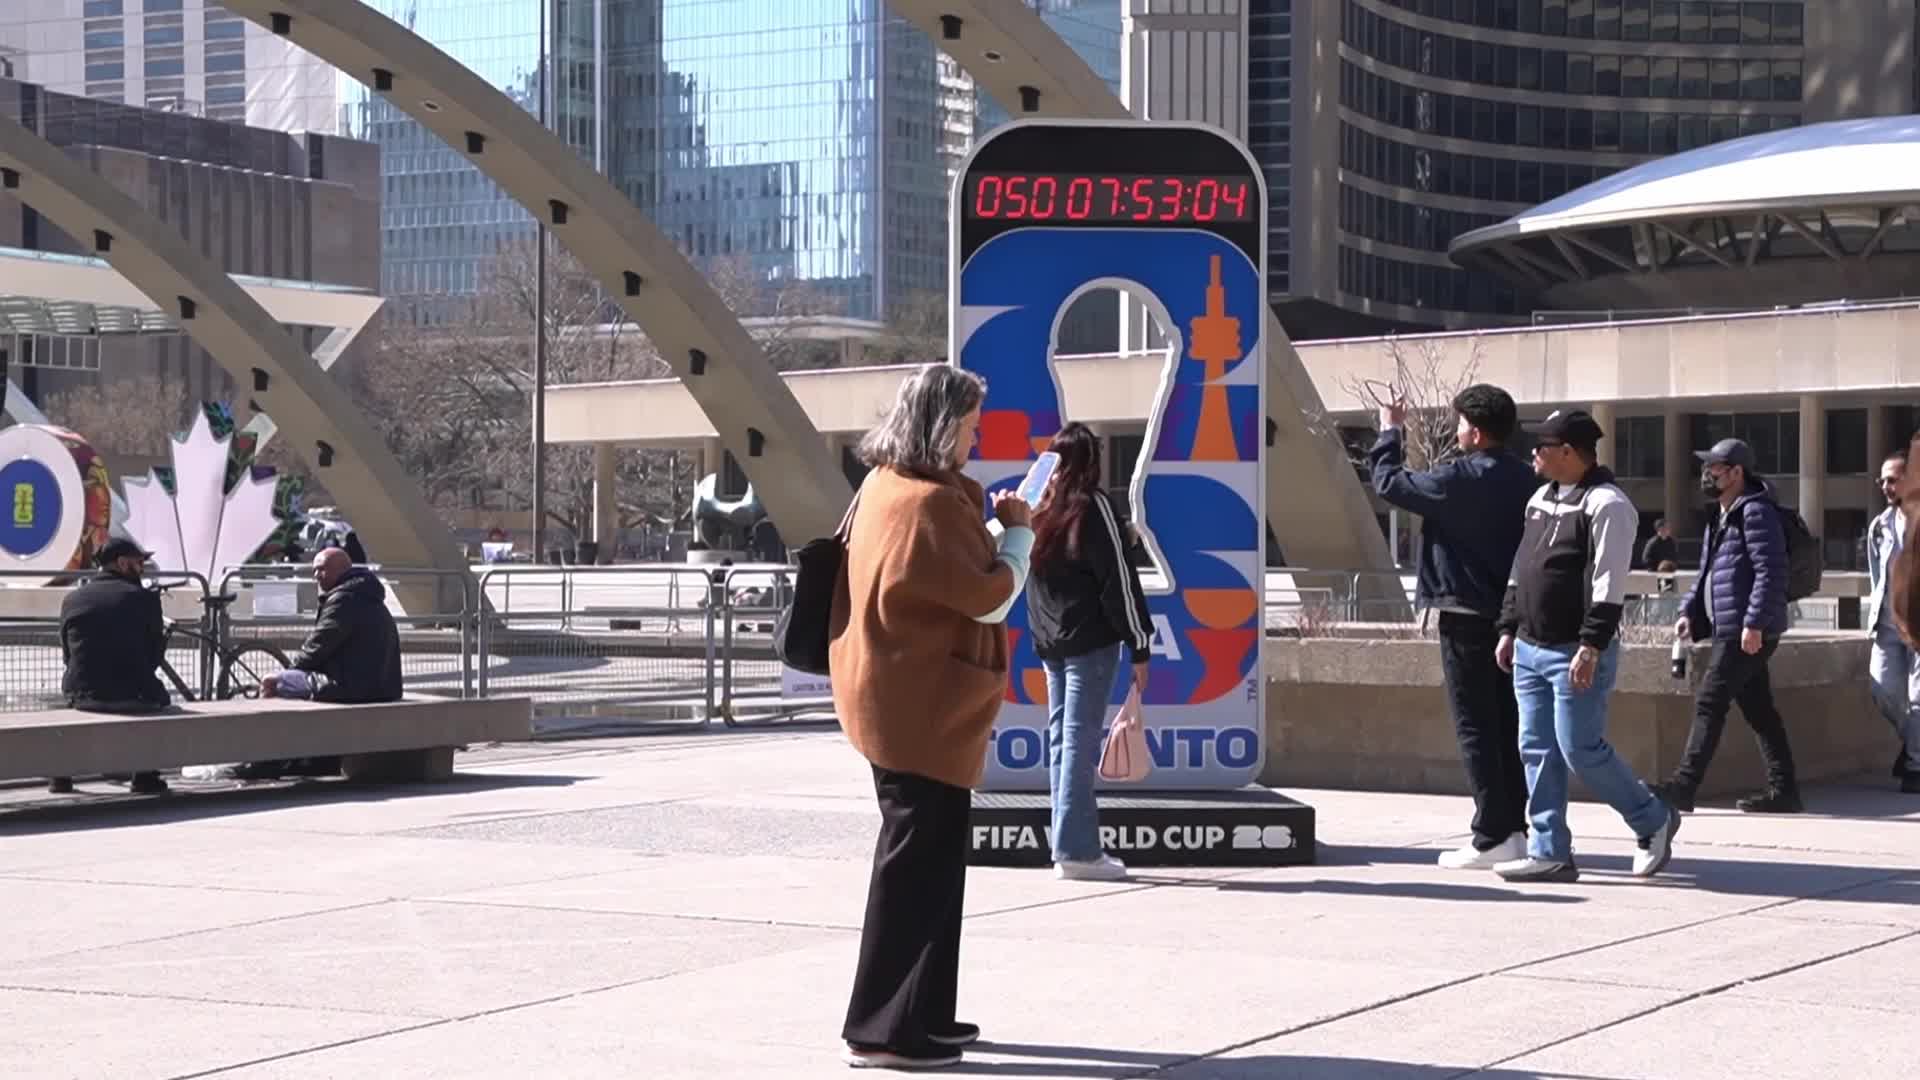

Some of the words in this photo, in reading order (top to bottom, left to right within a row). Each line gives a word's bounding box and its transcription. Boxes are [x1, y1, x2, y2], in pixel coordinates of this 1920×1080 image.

[976, 176, 1056, 218] 050
[1066, 177, 1246, 221] 07:53:04
[988, 728, 1259, 769] ONTO
[972, 826, 1039, 849] FIFA
[1043, 825, 1157, 849] RLD
[1163, 825, 1225, 849] CUP
